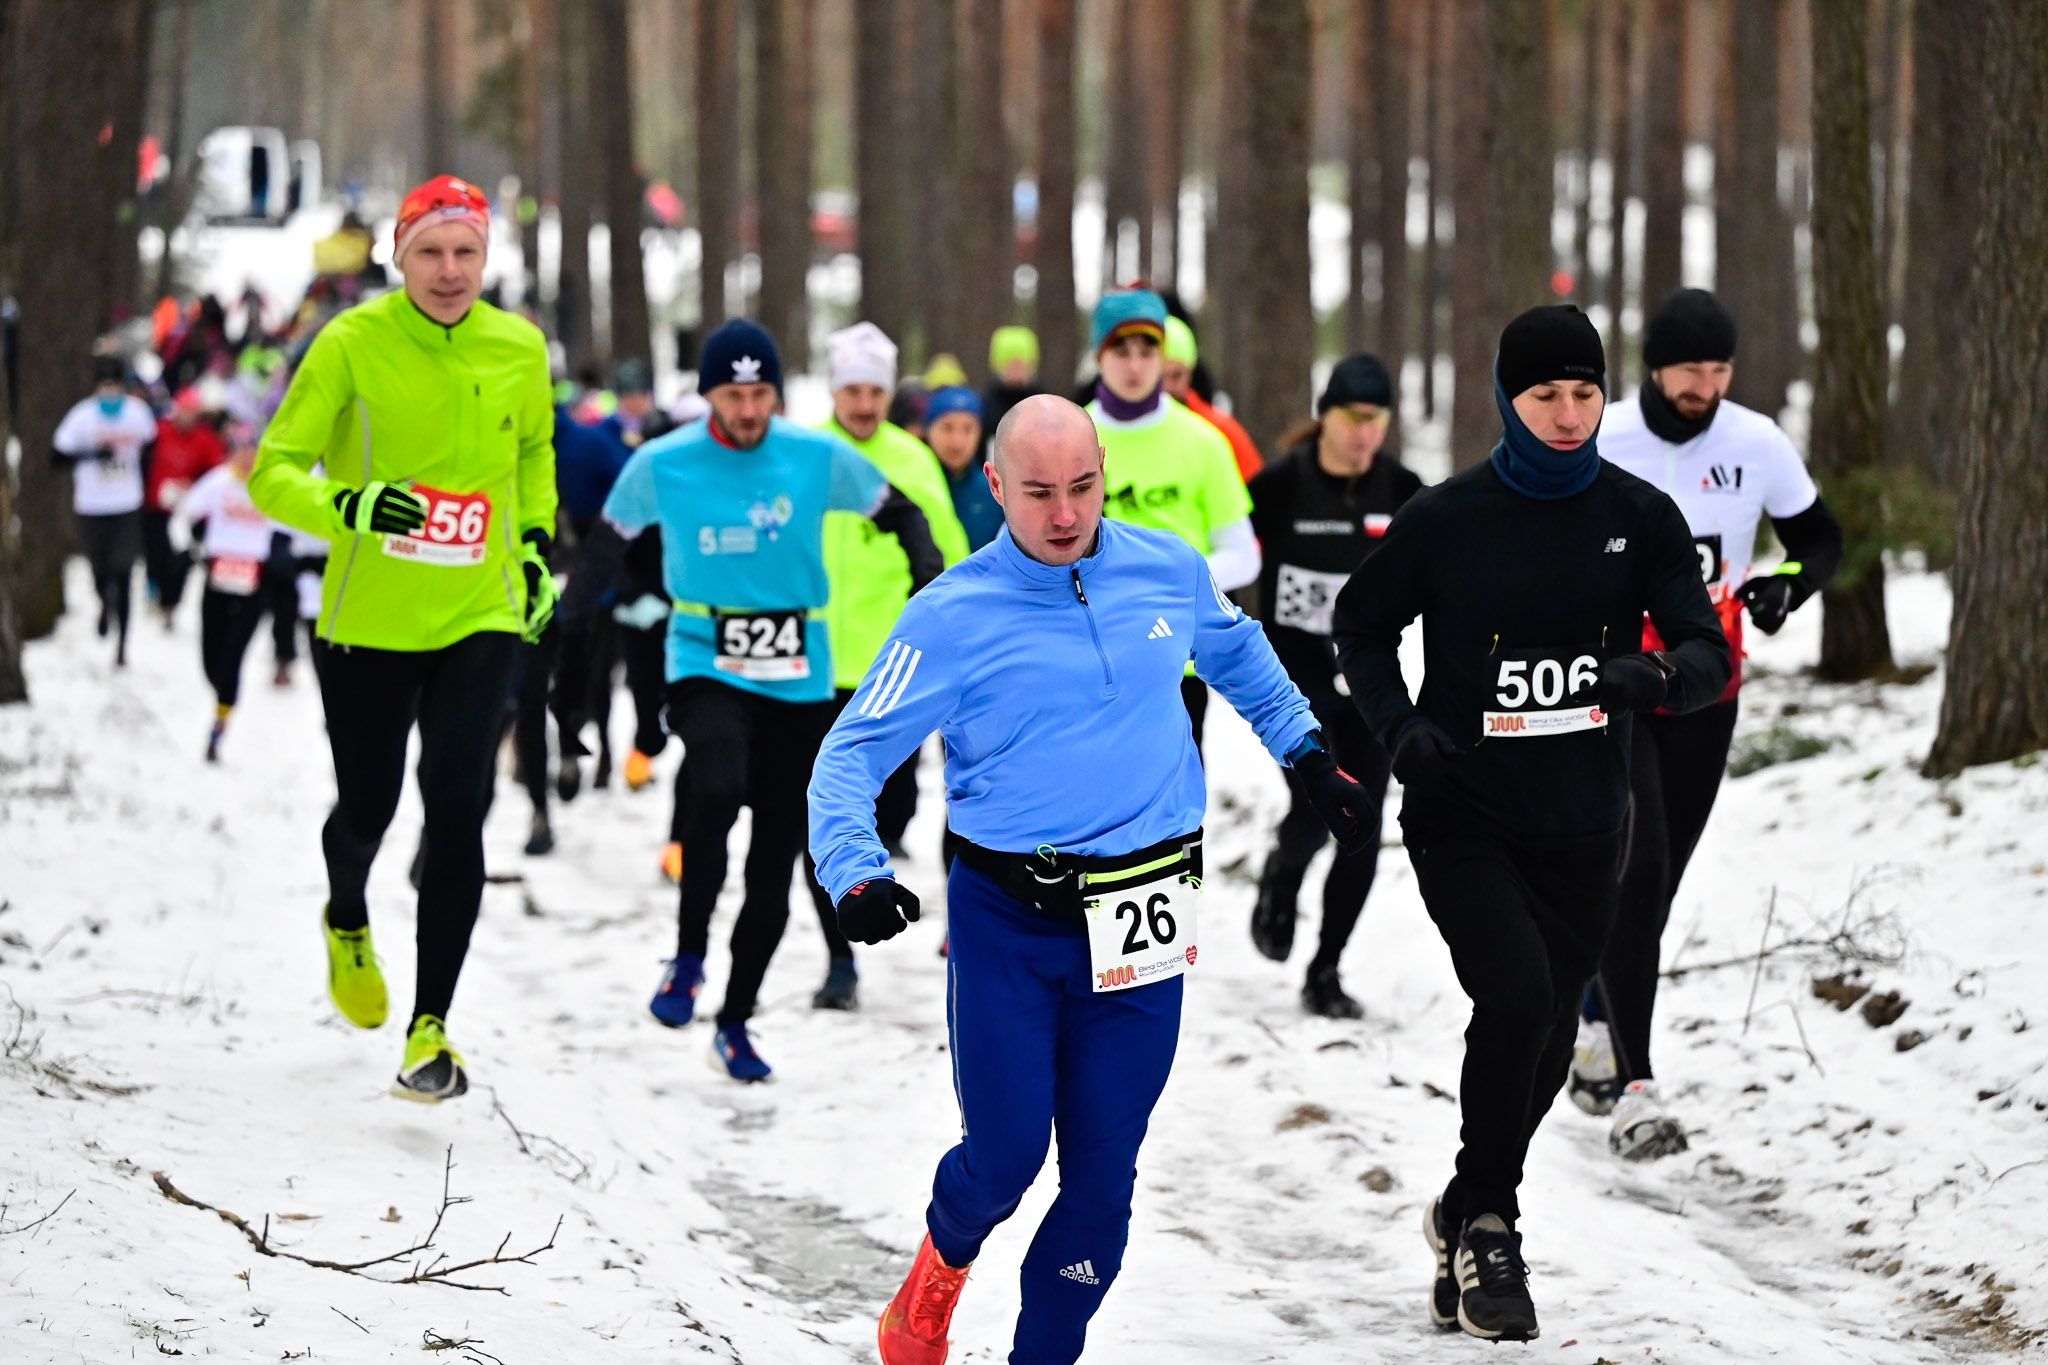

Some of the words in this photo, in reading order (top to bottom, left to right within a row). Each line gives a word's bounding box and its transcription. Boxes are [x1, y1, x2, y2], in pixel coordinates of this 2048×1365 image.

[723, 616, 801, 657] 524
[1496, 654, 1599, 708] 506
[1115, 892, 1177, 956] 26
[1059, 1268, 1100, 1285] adidas
